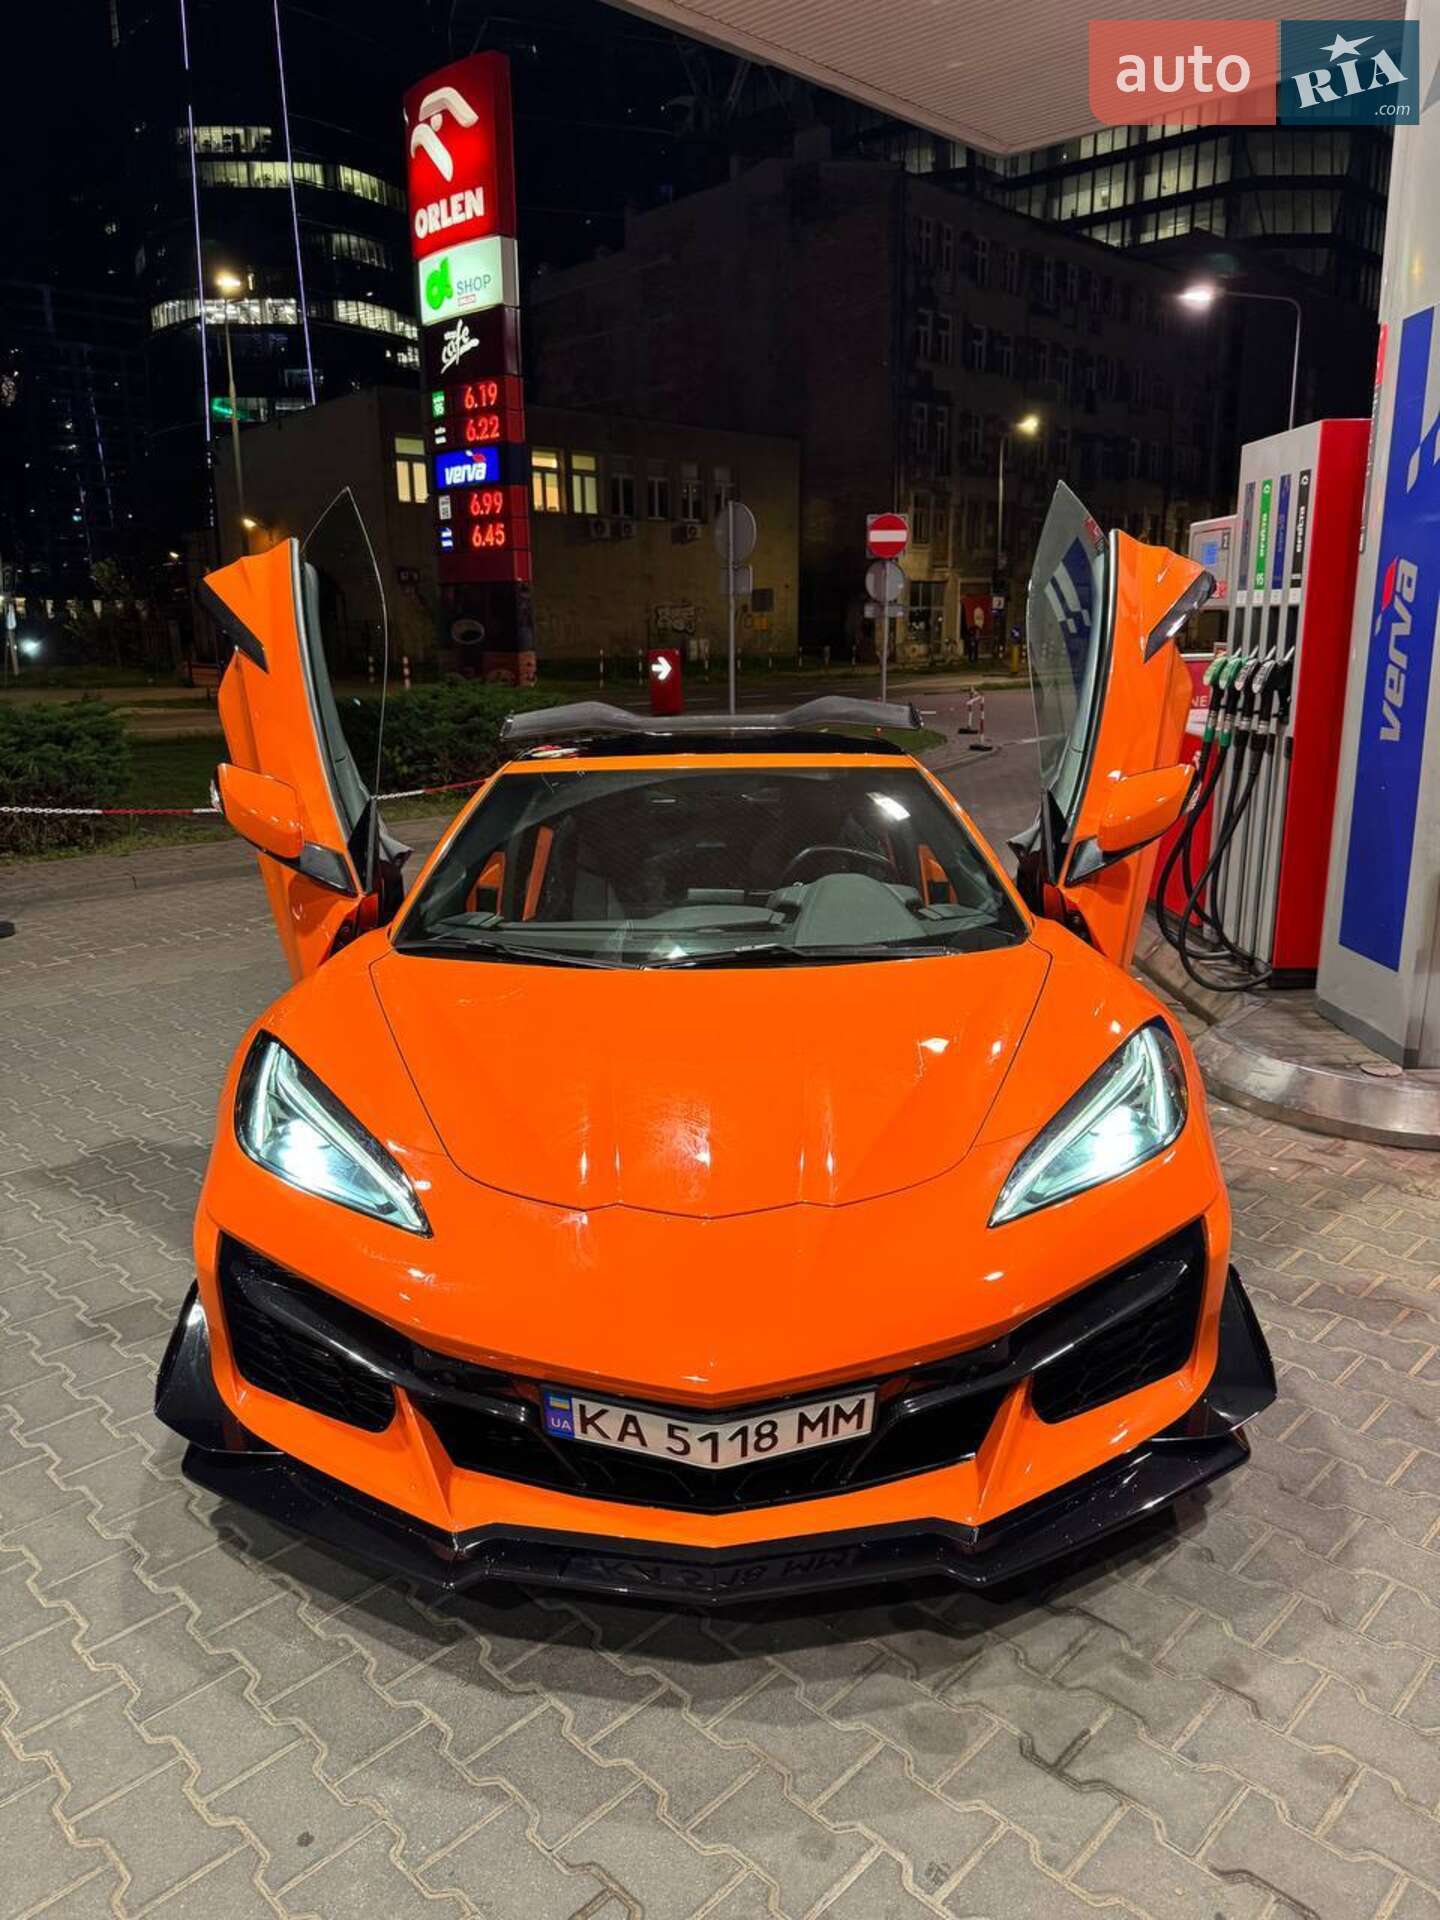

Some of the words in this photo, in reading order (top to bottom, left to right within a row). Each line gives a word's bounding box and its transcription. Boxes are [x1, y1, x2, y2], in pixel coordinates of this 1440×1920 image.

[415, 186, 485, 239] ORLEN
[456, 274, 492, 296] SHOP
[464, 382, 498, 409] 6.19
[466, 415, 501, 442] 6.22
[445, 462, 487, 486] verva
[470, 491, 504, 516] 6.99
[472, 523, 506, 548] 6.45
[1379, 557, 1418, 742] verva
[551, 1416, 572, 1431] UA
[579, 1403, 648, 1448] KA
[666, 1419, 779, 1464] 5118
[796, 1398, 867, 1445] MM
